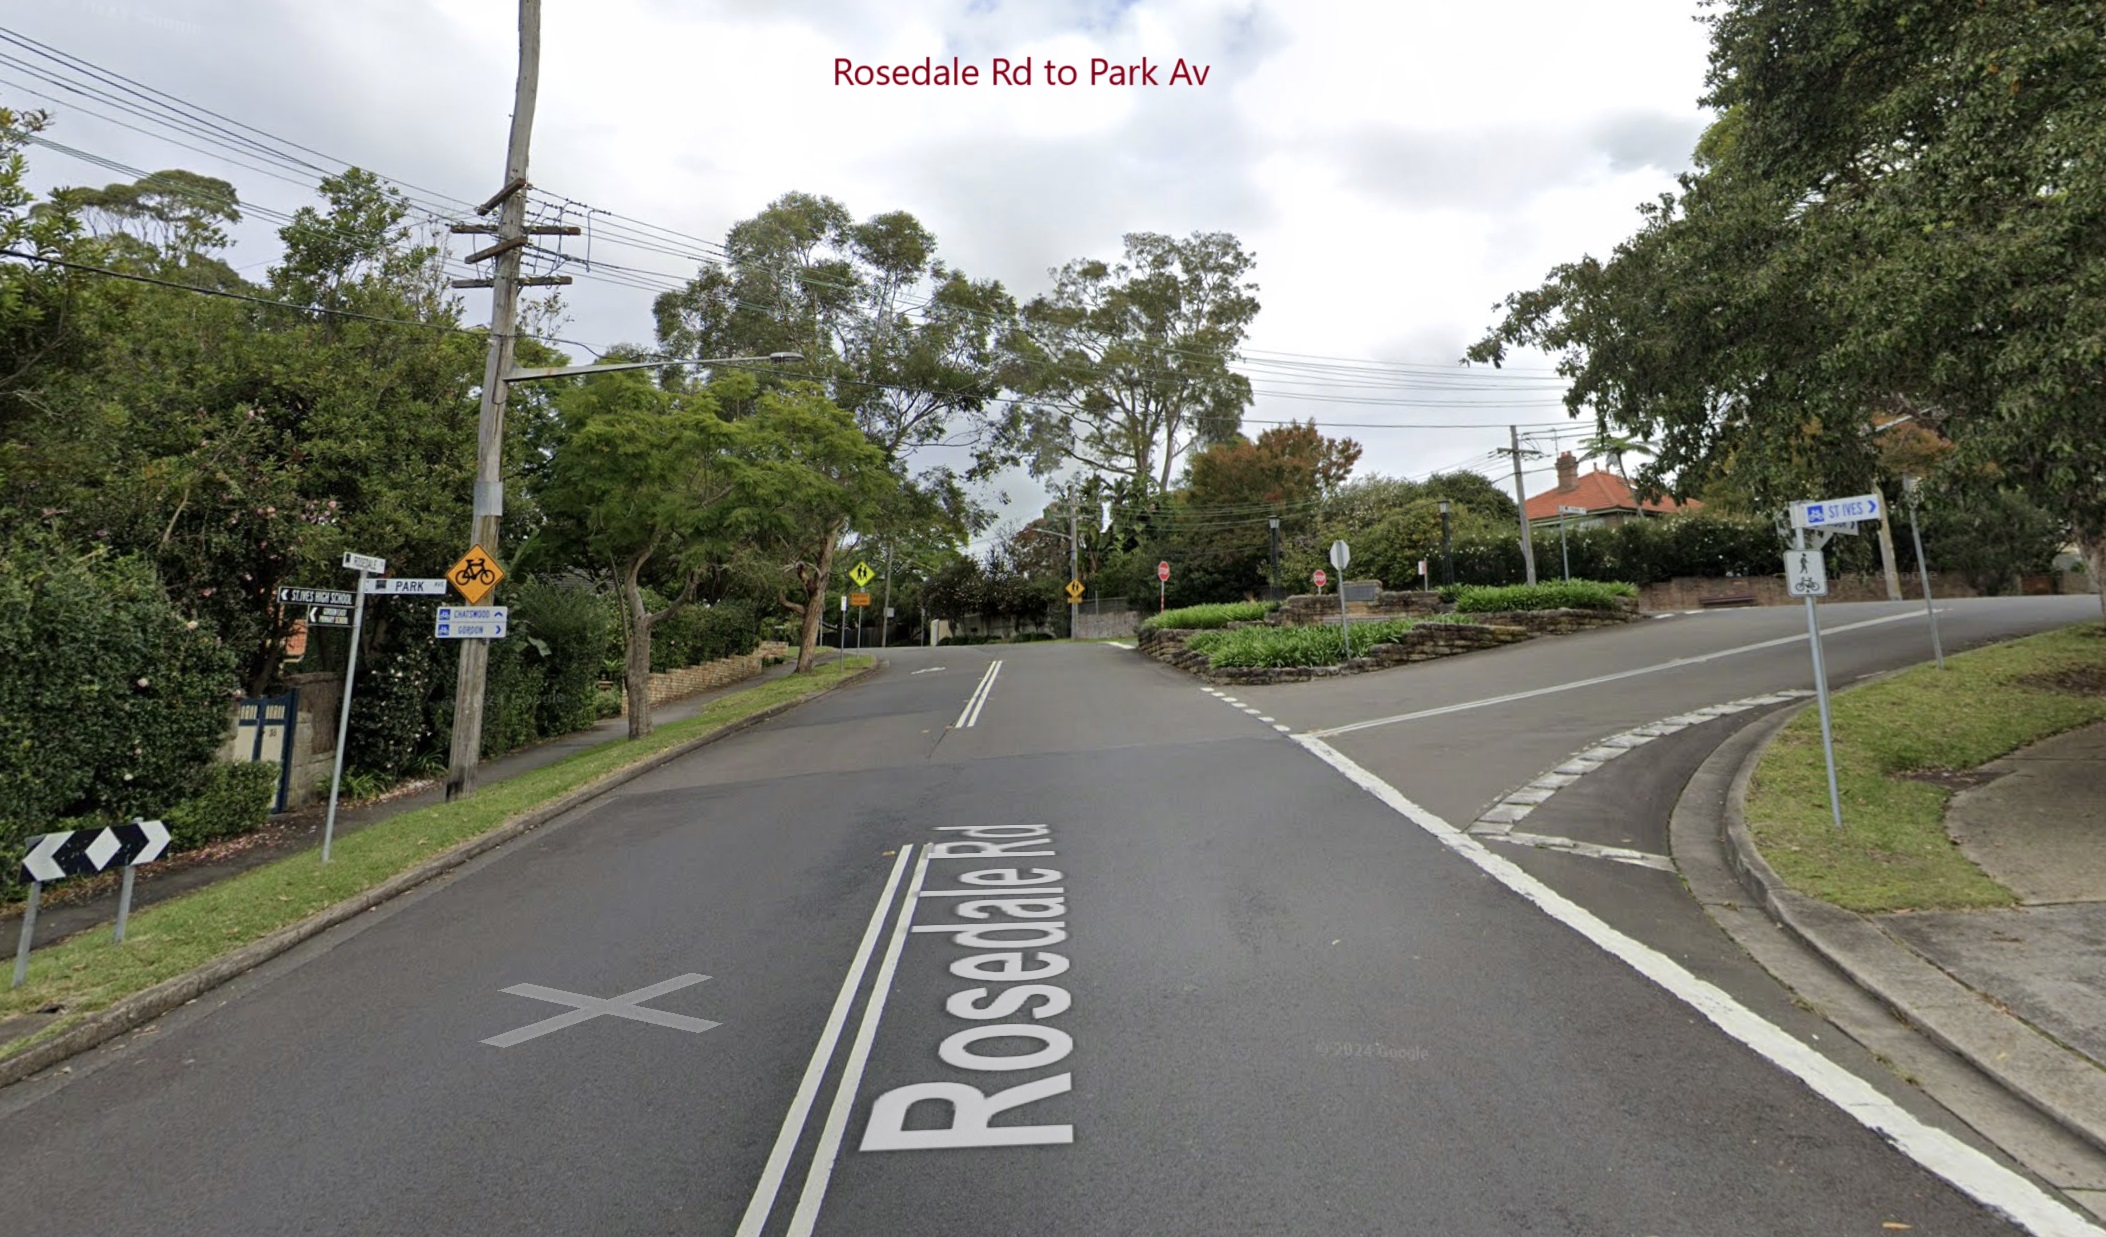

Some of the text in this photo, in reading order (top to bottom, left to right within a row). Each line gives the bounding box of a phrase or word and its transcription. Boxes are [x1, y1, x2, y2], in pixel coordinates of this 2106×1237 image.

[1829, 501, 1863, 518] ST IVES
[395, 581, 424, 592] PARK
[330, 592, 352, 605] SCHOOL
[454, 610, 490, 618] CHATSWOOD
[458, 626, 483, 635] GORDON
